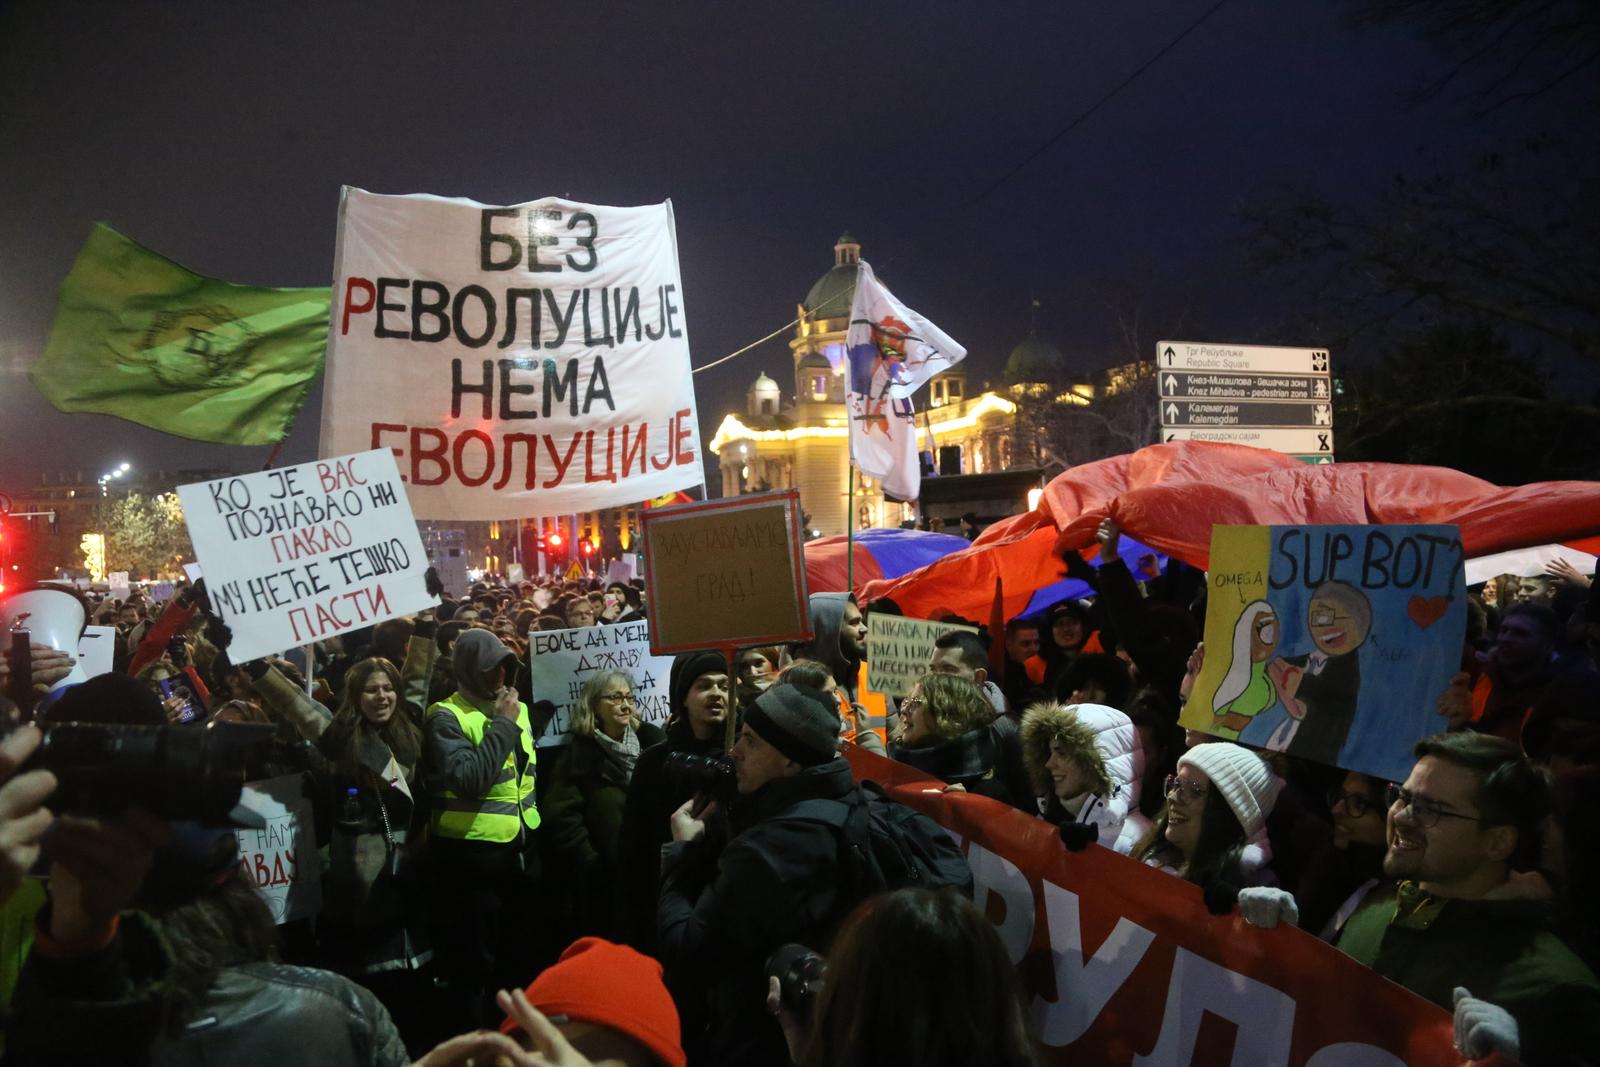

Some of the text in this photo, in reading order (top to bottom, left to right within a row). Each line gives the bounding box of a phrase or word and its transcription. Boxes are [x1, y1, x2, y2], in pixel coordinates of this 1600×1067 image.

[480, 208, 598, 273] БЕЗ
[342, 276, 683, 350] РЕВОЛУЦИЈЕ
[1186, 358, 1250, 370] Republic Square
[451, 355, 616, 421] НЕМА
[1187, 386, 1208, 396] Knez
[1210, 387, 1246, 397] Mihailova
[1251, 388, 1290, 399] pedestrian
[1290, 390, 1308, 399] zone
[1188, 403, 1239, 414] Калемегдан
[1188, 414, 1239, 425] Kalemegdan
[371, 408, 695, 491] ЕВОЛУЦИЈЕ
[208, 457, 368, 514] КО ЈЕ ВАС
[225, 489, 363, 541] ПОЗНАВАО
[270, 520, 353, 563] ПАКАО
[1268, 529, 1351, 590] SUP
[212, 580, 247, 620] МУ
[247, 563, 330, 612] НЕЋЕ
[329, 537, 411, 586] ТЕШКО
[1215, 571, 1263, 588] OMEGA
[288, 584, 392, 642] ПАСТИ
[872, 619, 922, 640] NIKADA
[535, 625, 650, 655] БОЉЕ ДА МЕЊ
[574, 647, 644, 677] ДРЖАВУ
